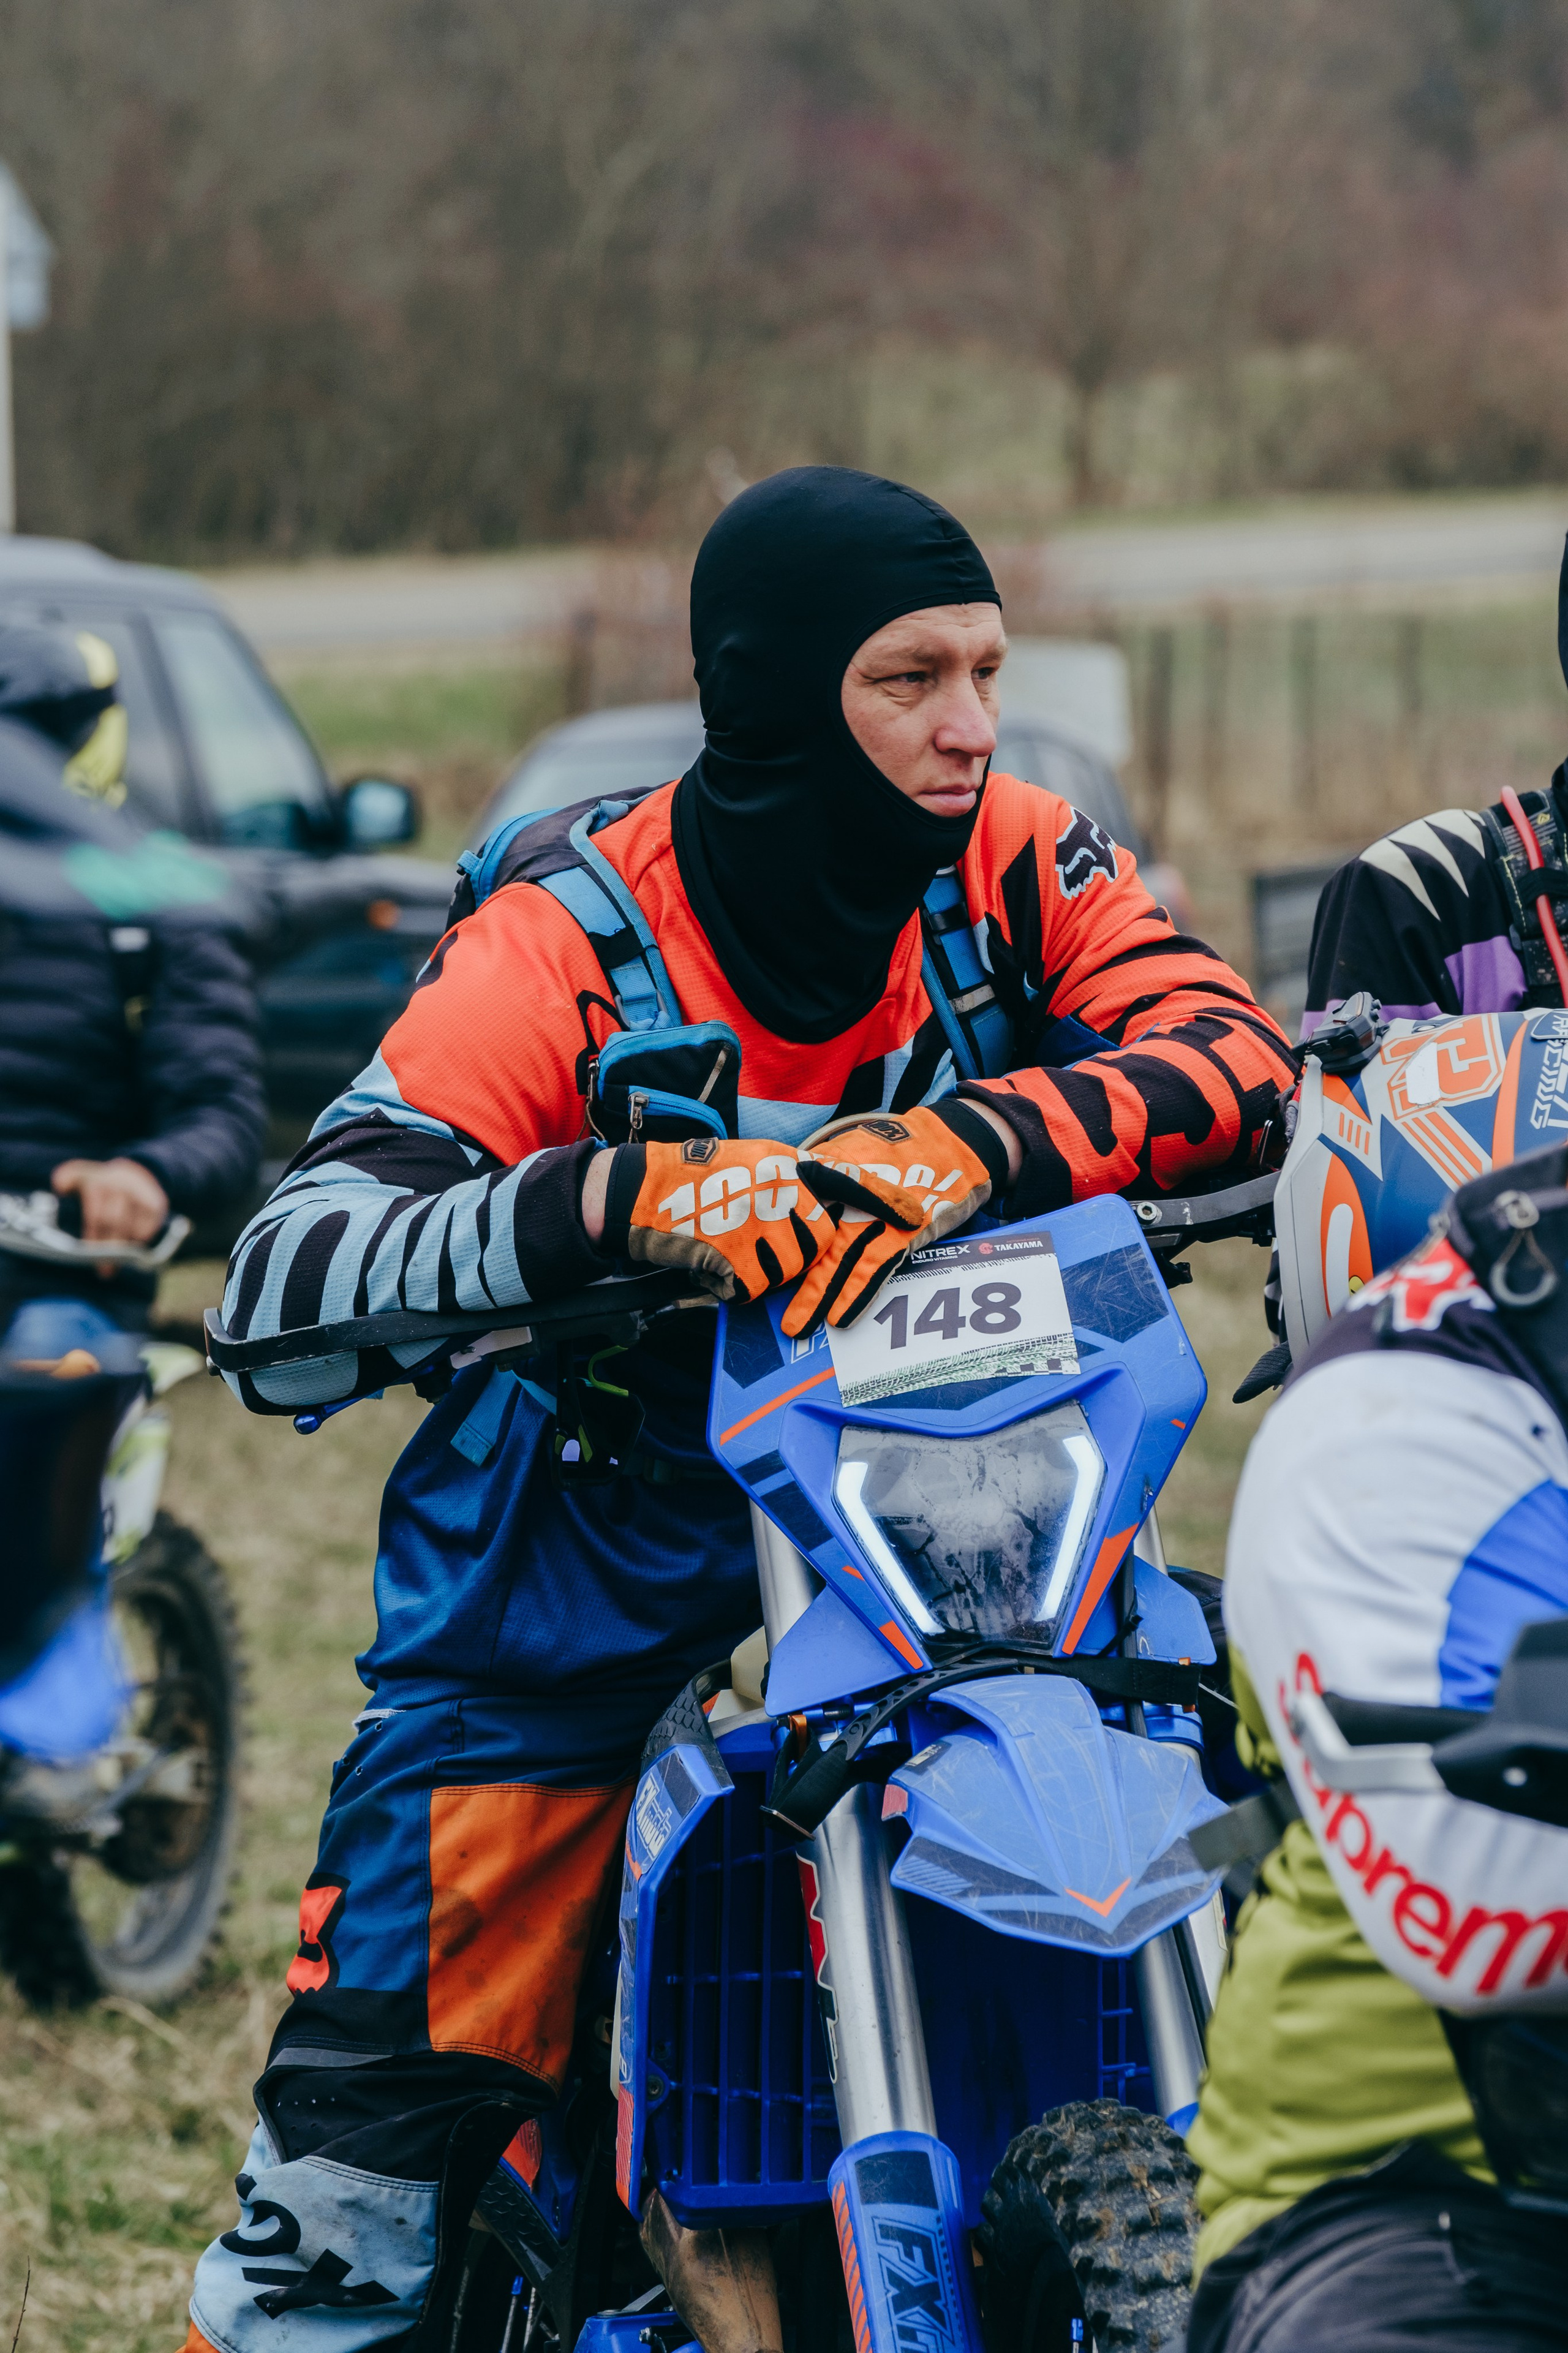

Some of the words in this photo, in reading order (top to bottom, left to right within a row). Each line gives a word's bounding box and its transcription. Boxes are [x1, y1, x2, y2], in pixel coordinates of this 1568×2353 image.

[911, 1244, 971, 1260] NITREX
[994, 1240, 1044, 1252] TAKAYAMA
[874, 1282, 1022, 1350] 148
